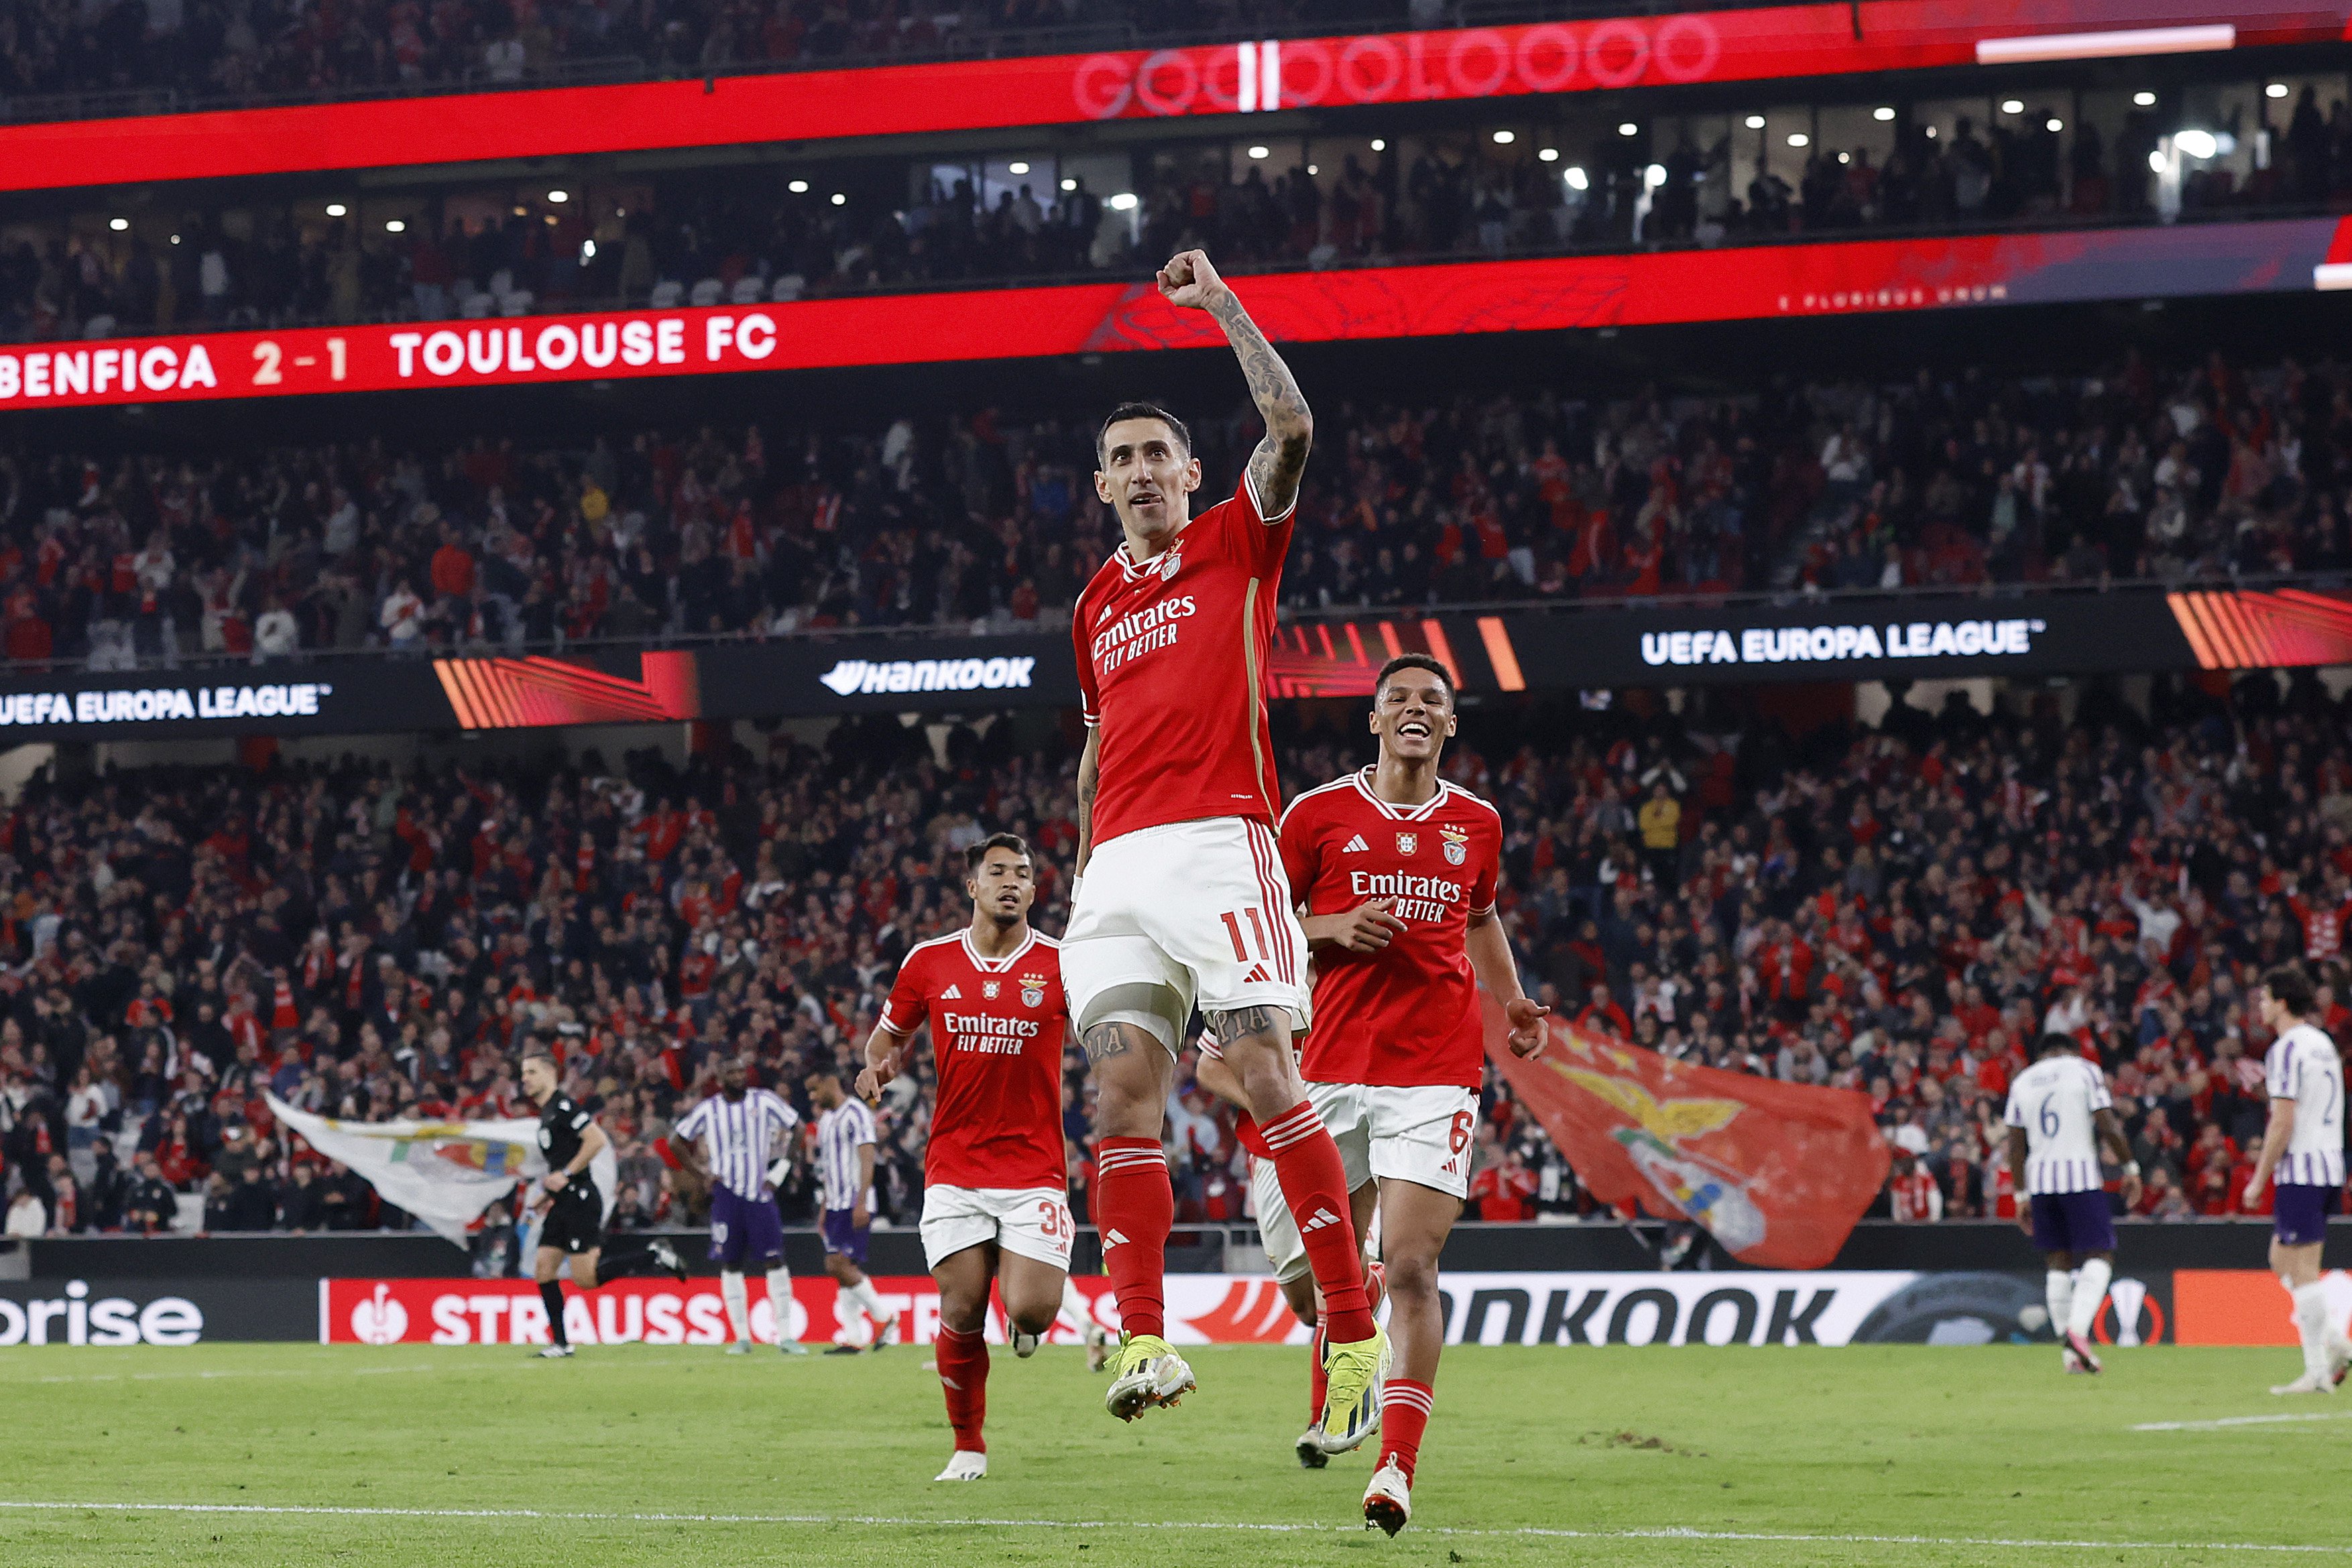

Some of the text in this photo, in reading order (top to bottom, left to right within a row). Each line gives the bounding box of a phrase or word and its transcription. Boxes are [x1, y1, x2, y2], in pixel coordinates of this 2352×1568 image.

[0, 345, 217, 399] BENFICA
[389, 318, 685, 377] TOULOUSE
[706, 313, 776, 361] FC
[1094, 595, 1196, 661] Emirates
[1642, 630, 1738, 665] UEFA
[1742, 625, 1883, 662] EUROPA
[1104, 623, 1177, 676] FLY BETTER
[0, 692, 73, 725] UEFA
[76, 688, 195, 722] EUROPA
[1350, 869, 1461, 903] Emirates
[1395, 898, 1445, 923] BETTER
[1220, 908, 1270, 963] 11
[943, 1012, 1039, 1037] Emirates
[957, 1034, 1023, 1055] FLY BETTER
[1449, 1111, 1474, 1156] 6
[2040, 1091, 2060, 1138] 6
[1039, 1201, 1071, 1240] 36
[431, 1294, 726, 1347] STRAUSS
